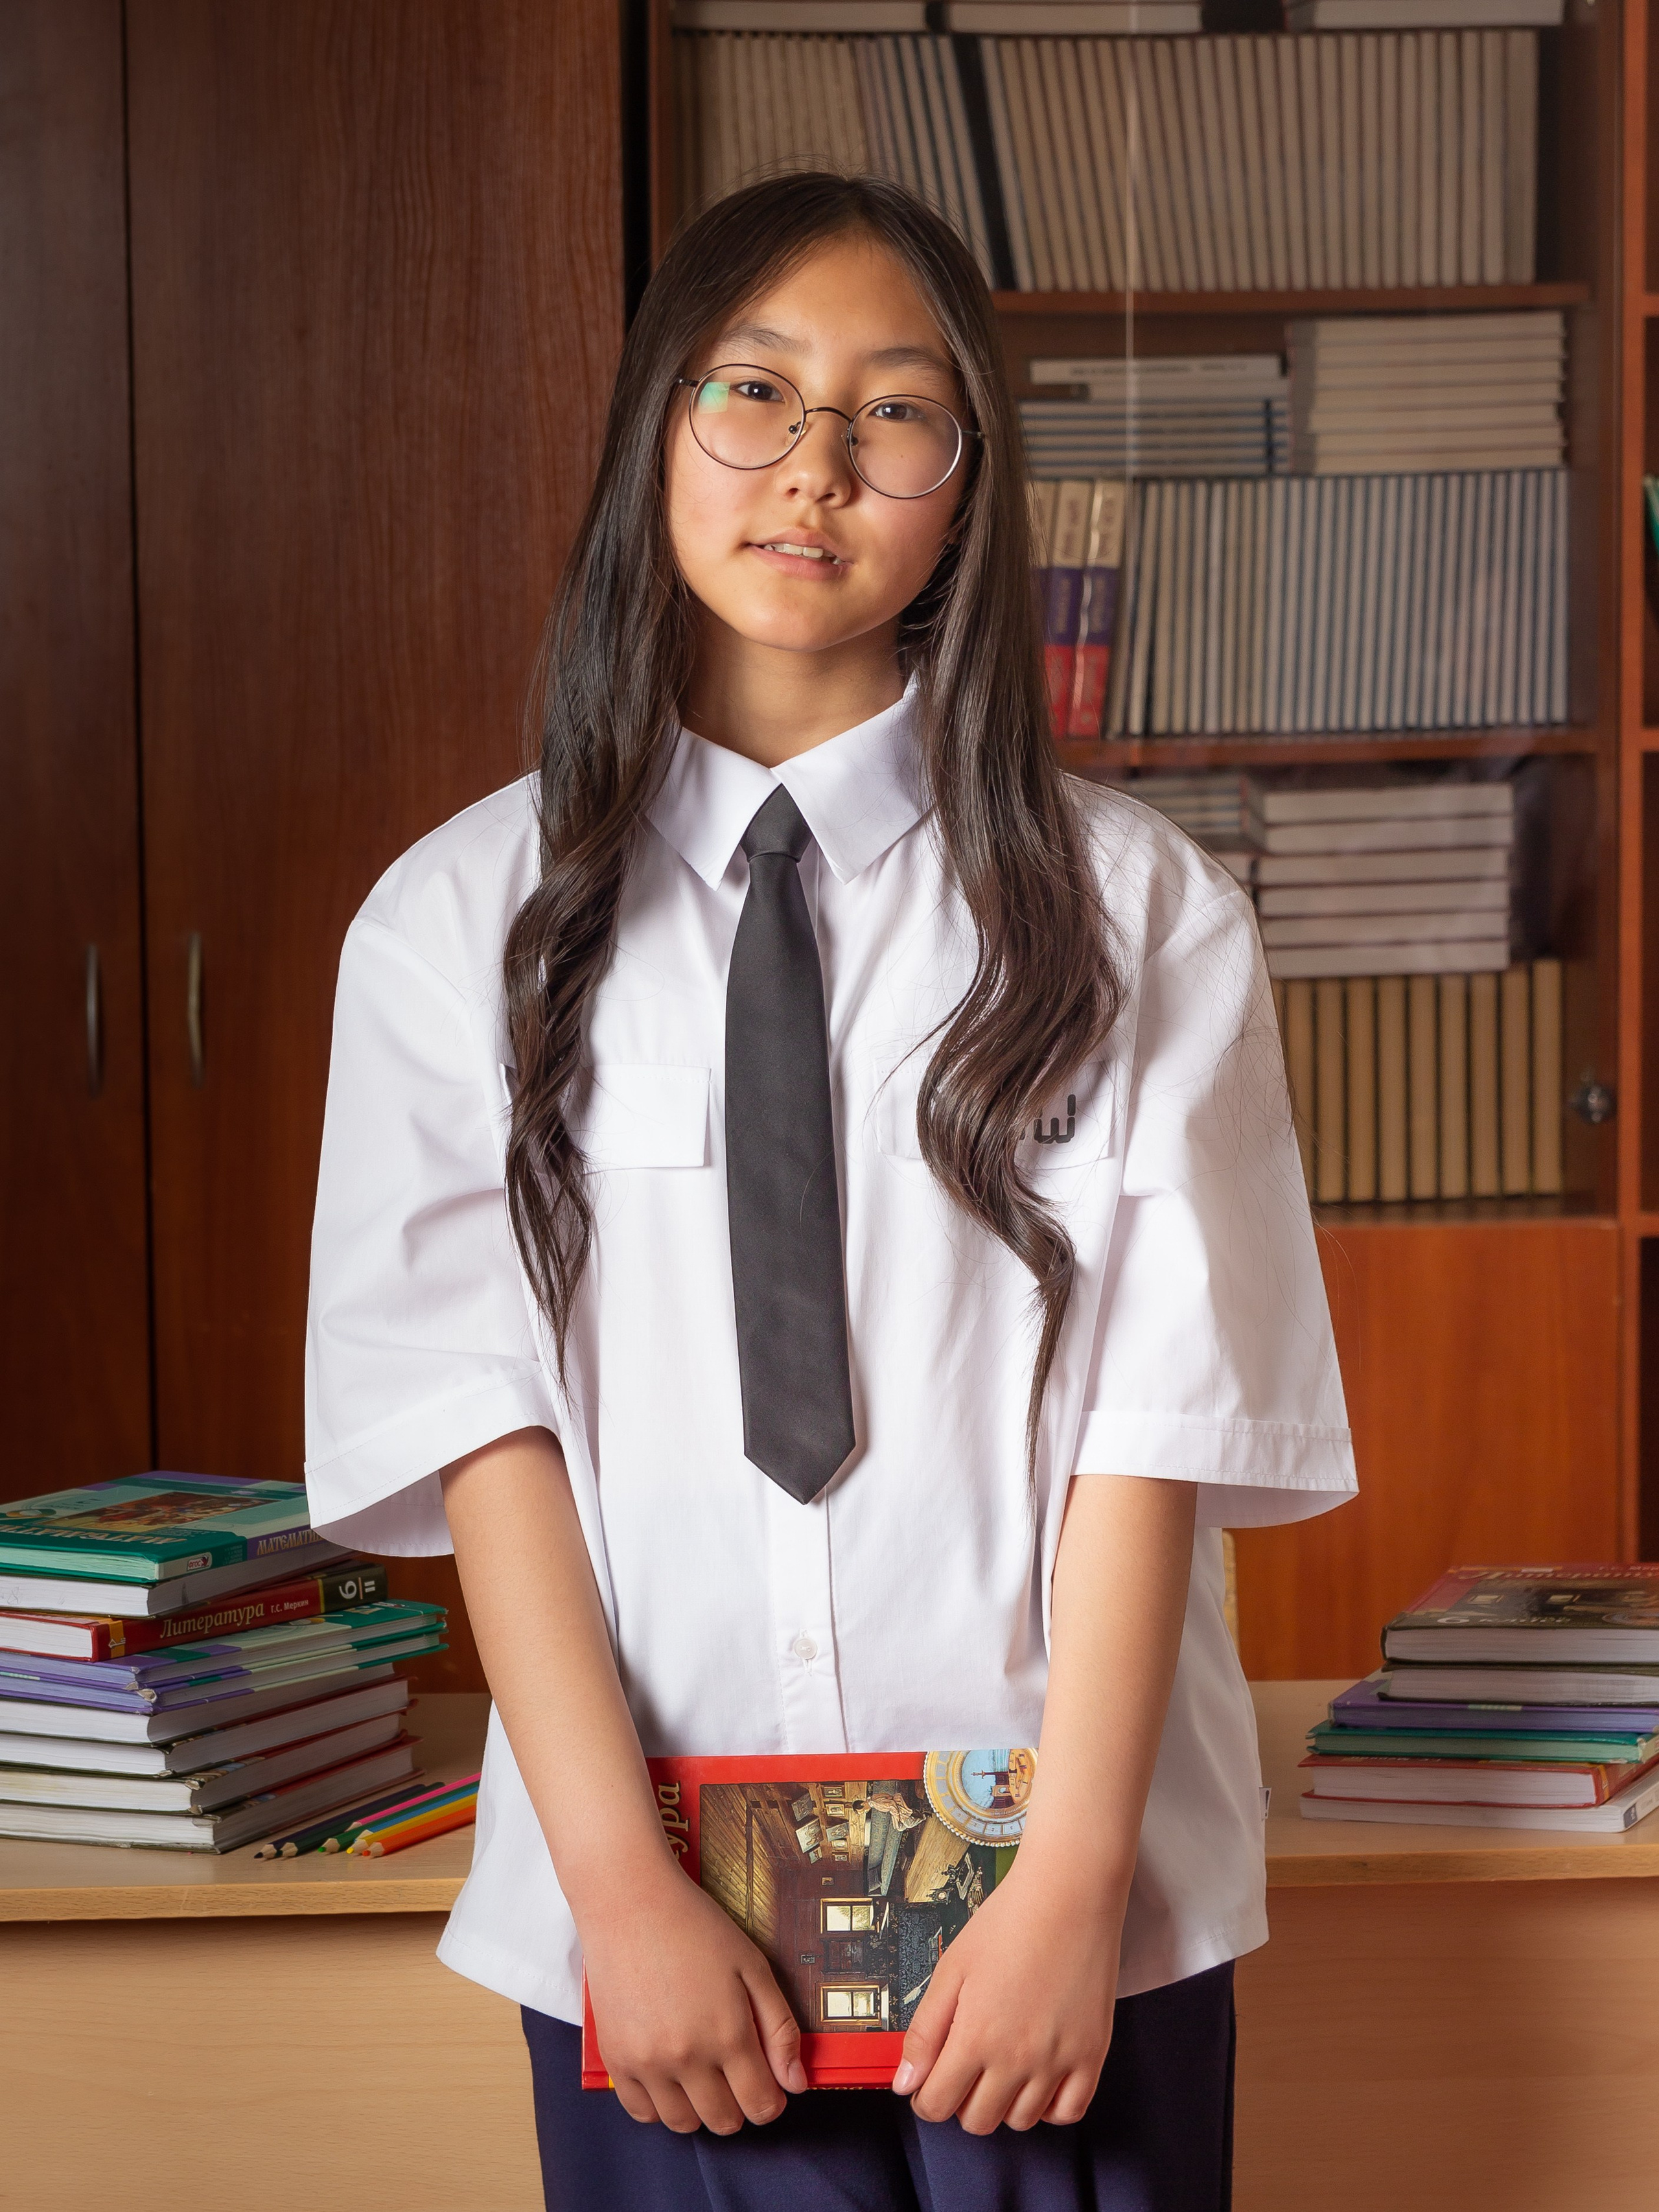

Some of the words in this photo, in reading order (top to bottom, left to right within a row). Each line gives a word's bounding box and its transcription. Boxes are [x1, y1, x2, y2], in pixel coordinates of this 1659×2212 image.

[189, 1559, 202, 1568] ФГОС
[160, 1602, 265, 1639] Литература
[284, 1600, 309, 1611] Меркин
[658, 1782, 689, 1860] ура
